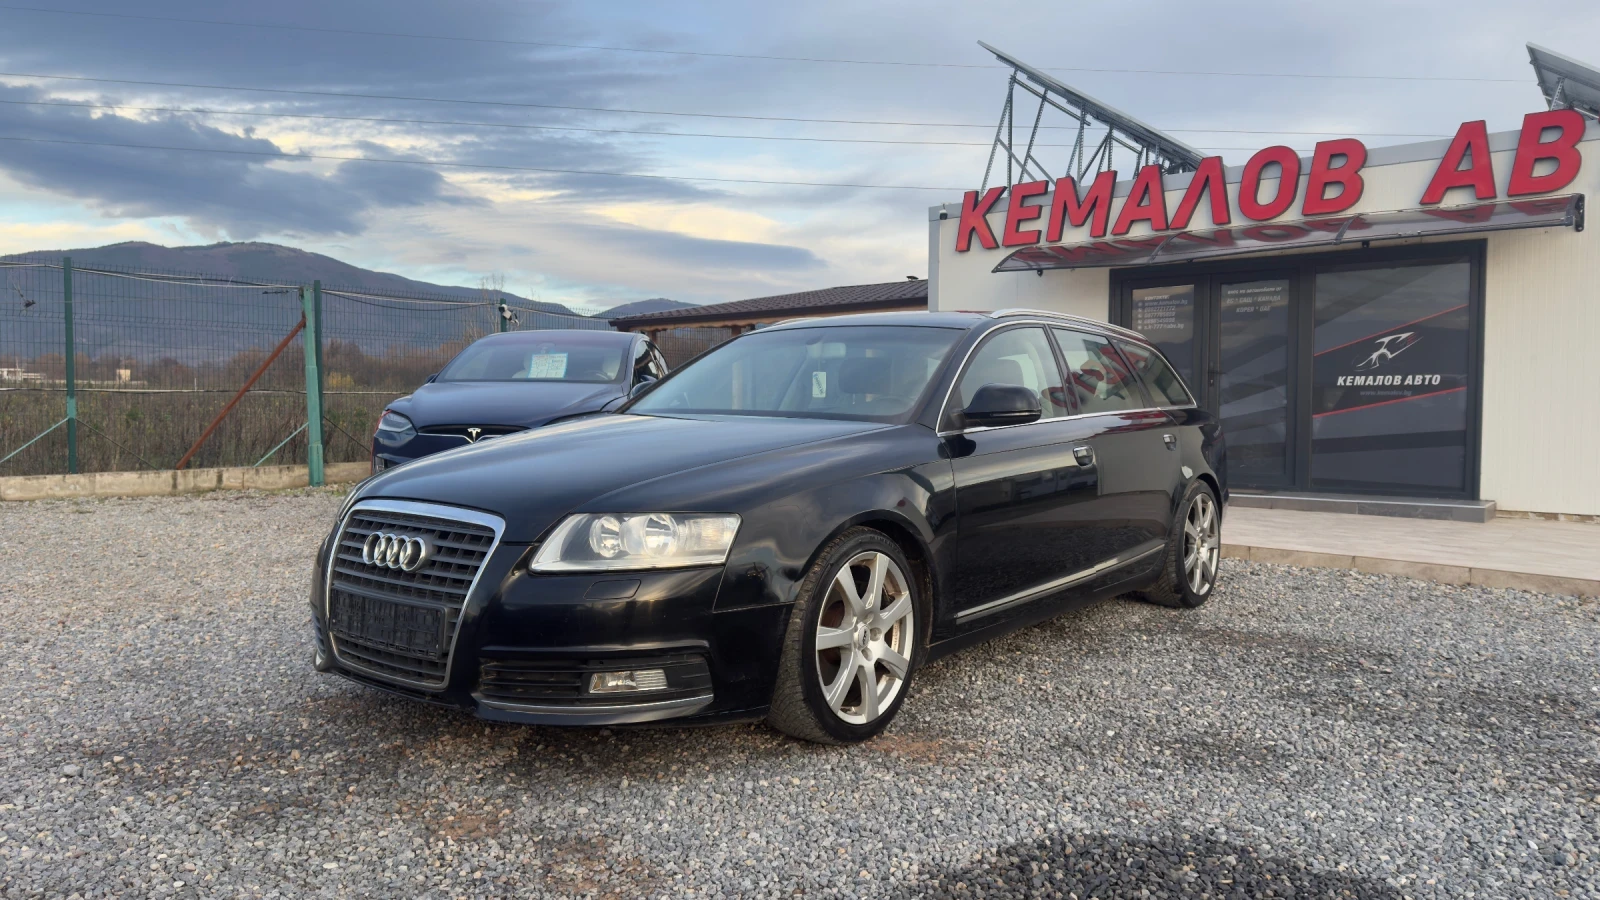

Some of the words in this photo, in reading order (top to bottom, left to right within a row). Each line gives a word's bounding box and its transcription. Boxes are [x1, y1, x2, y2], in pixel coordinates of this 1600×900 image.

[954, 137, 1369, 253] КЕМАЛОВ
[1419, 108, 1600, 205] АВ
[1336, 375, 1402, 386] КЕМАЛОВ
[1404, 374, 1441, 386] АВТО
